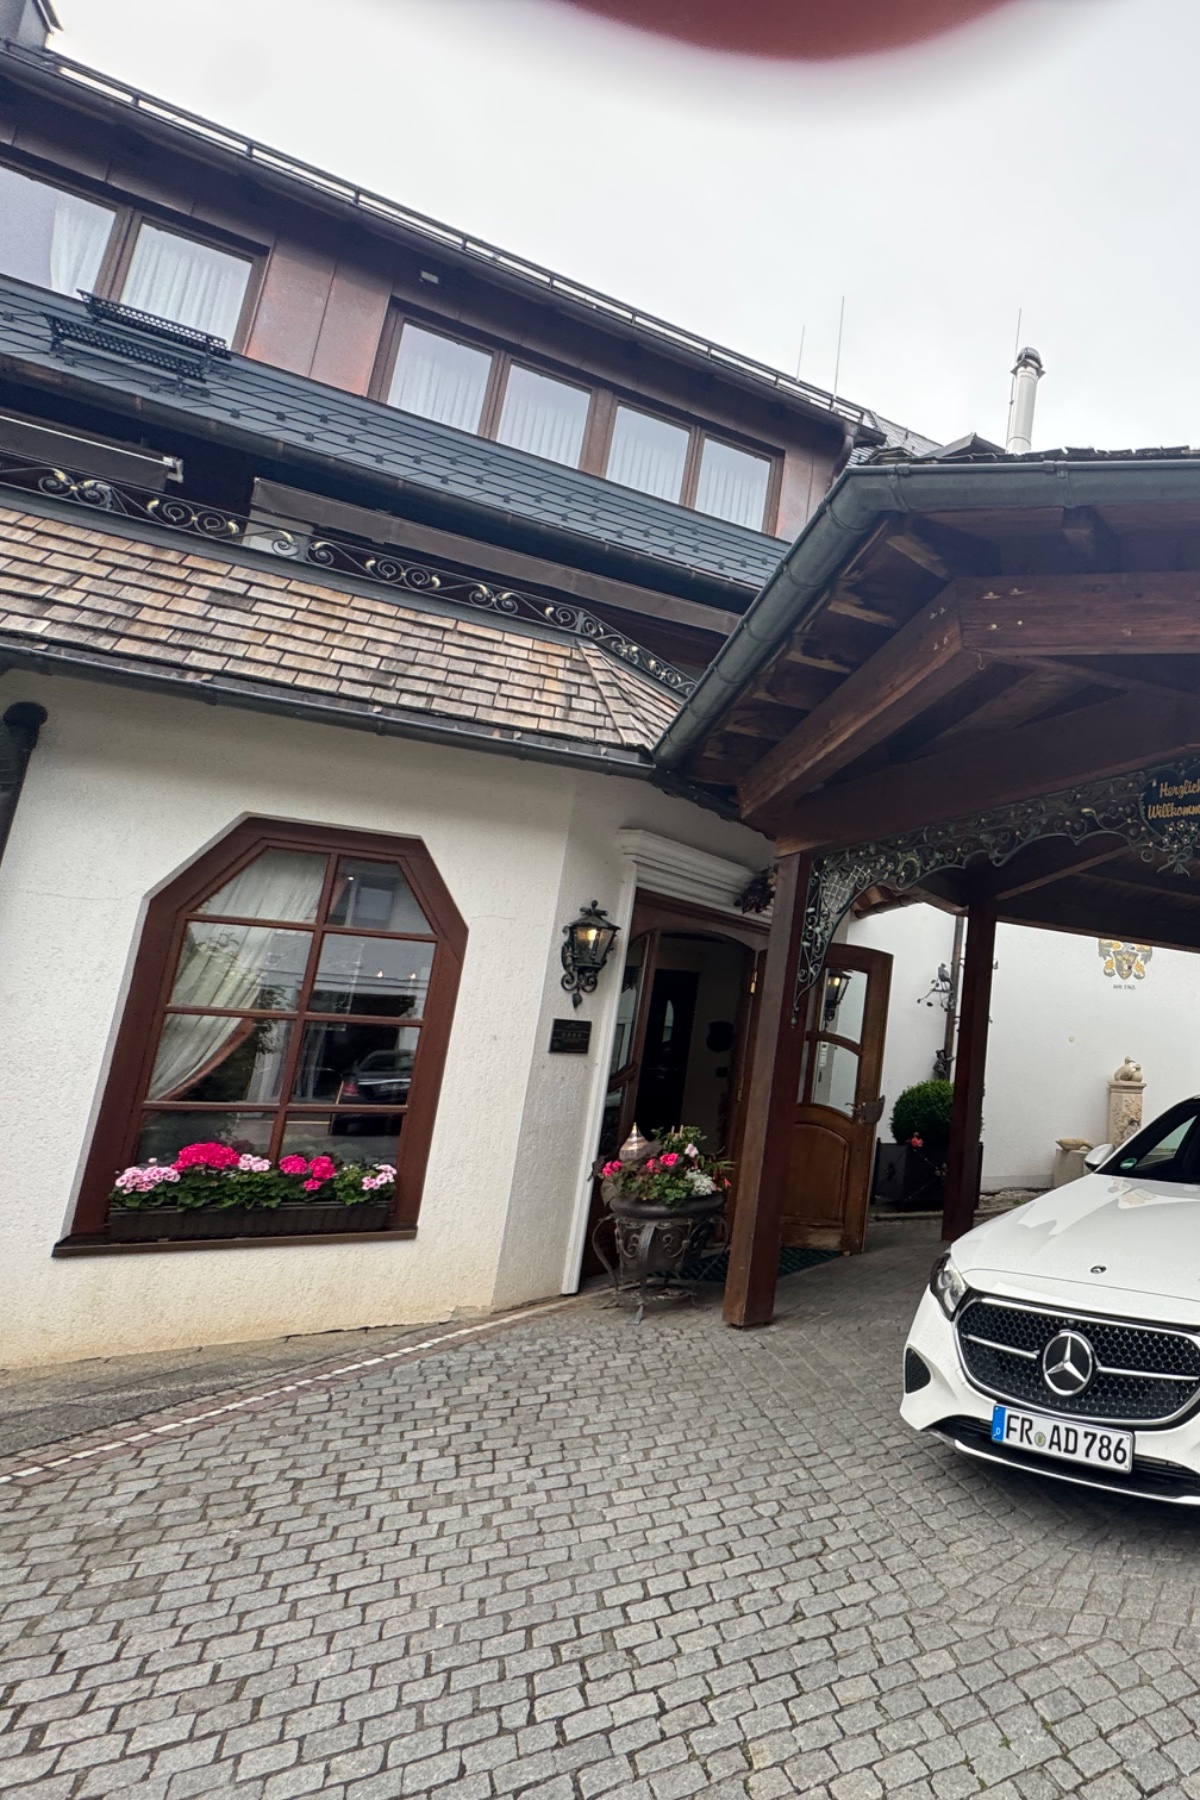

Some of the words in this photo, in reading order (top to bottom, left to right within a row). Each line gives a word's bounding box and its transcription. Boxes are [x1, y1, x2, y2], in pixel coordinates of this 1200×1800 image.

[1005, 1413, 1033, 1445] FR
[1049, 1424, 1079, 1455] AD
[1083, 1431, 1128, 1464] 786
